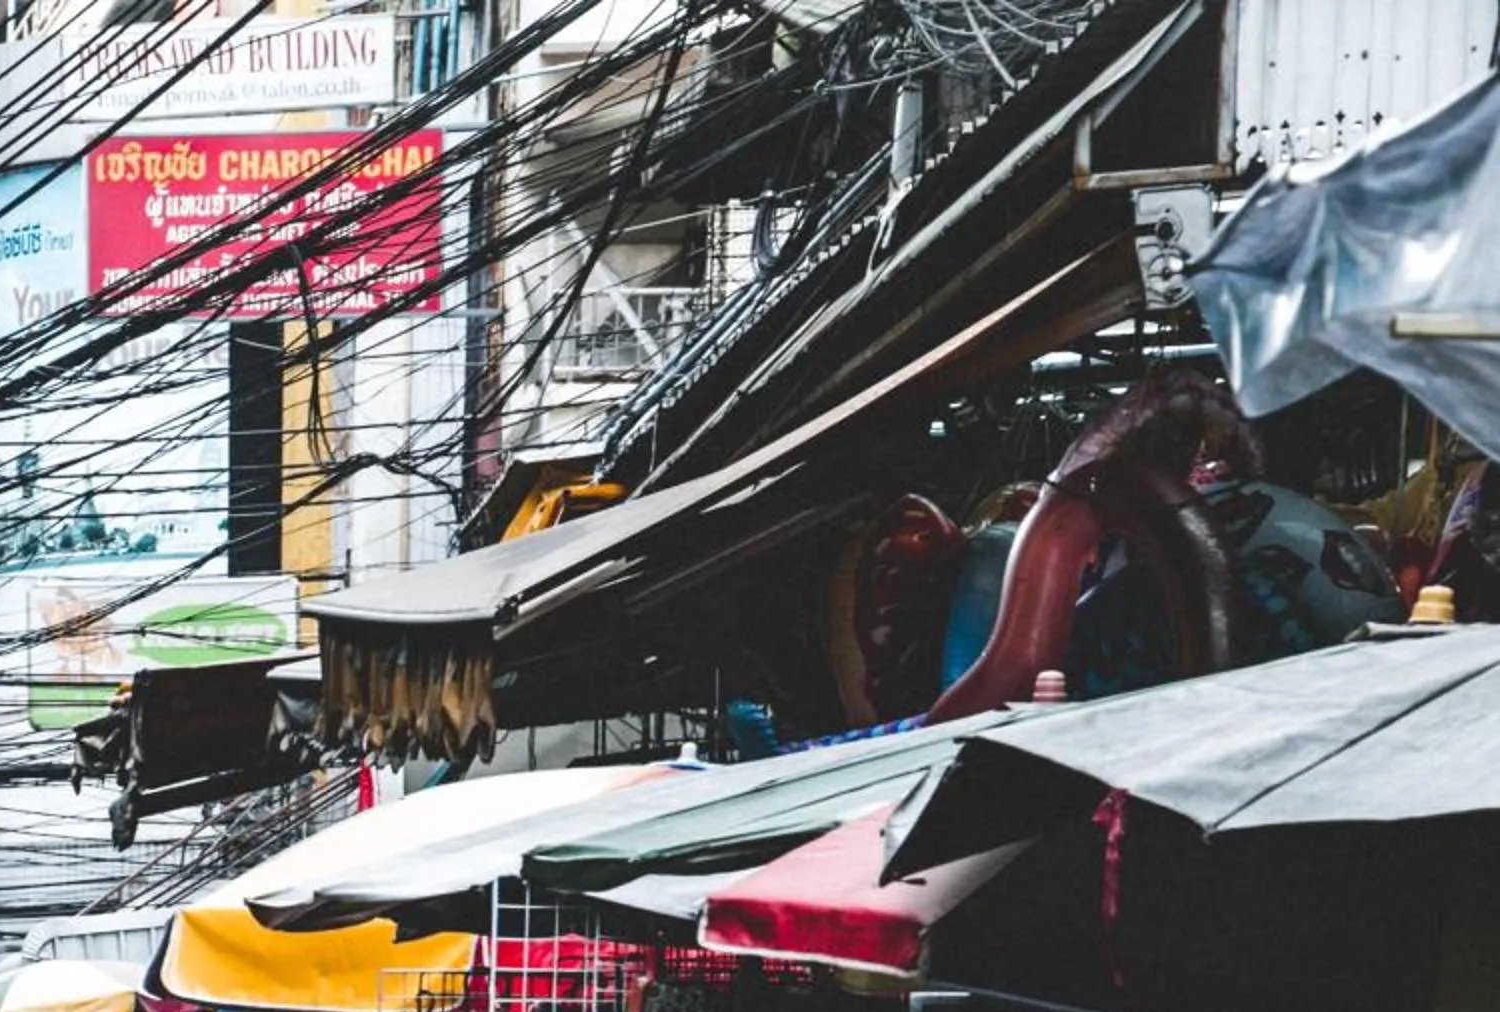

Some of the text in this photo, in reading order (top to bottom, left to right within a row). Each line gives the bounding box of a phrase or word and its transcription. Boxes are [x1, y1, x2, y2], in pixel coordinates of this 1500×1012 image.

[249, 28, 377, 73] BUILDING
[96, 141, 434, 188] เจริญชัย CHAROECHAI
